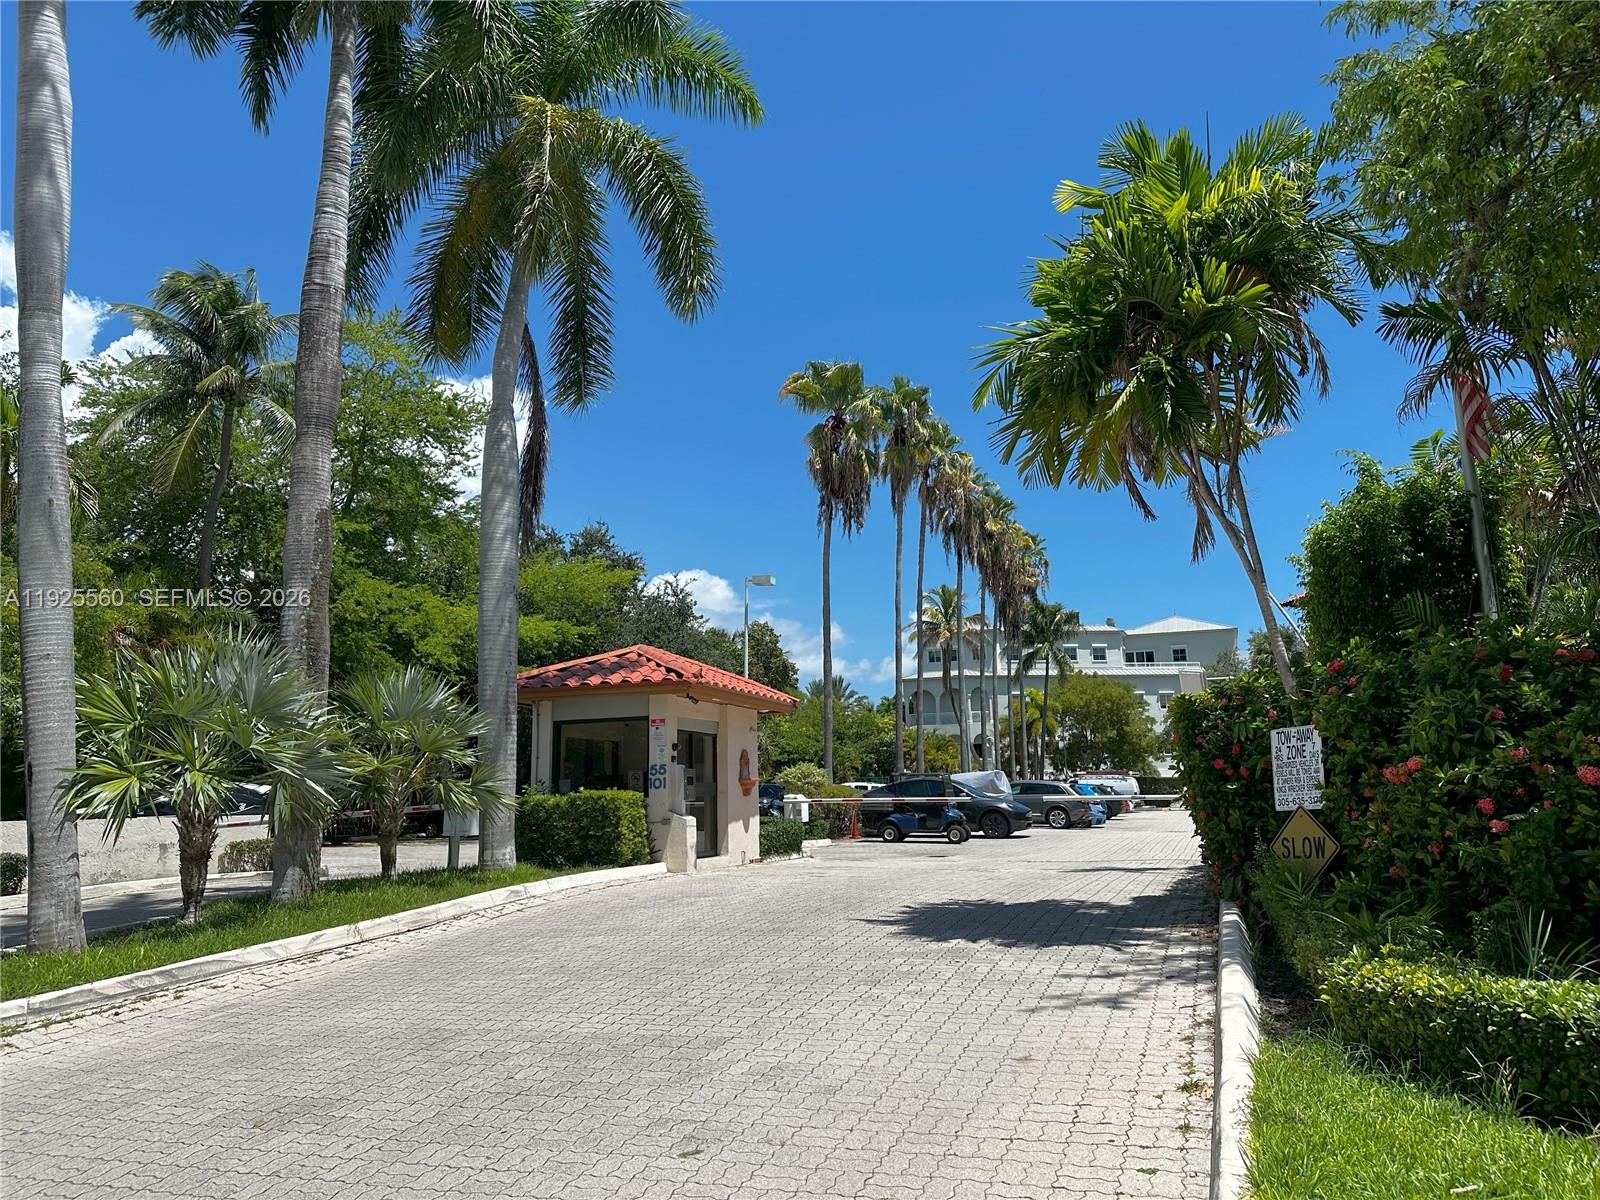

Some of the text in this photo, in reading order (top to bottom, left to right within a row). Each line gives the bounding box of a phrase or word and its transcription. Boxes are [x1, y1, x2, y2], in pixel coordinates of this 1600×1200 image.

[1276, 728, 1314, 745] TOW-AWAY
[1275, 746, 1281, 754] 24
[1286, 744, 1306, 760] ZONE
[1312, 742, 1316, 750] 7
[650, 764, 667, 776] 55
[649, 777, 666, 789] 101
[1282, 837, 1326, 859] SLOW
